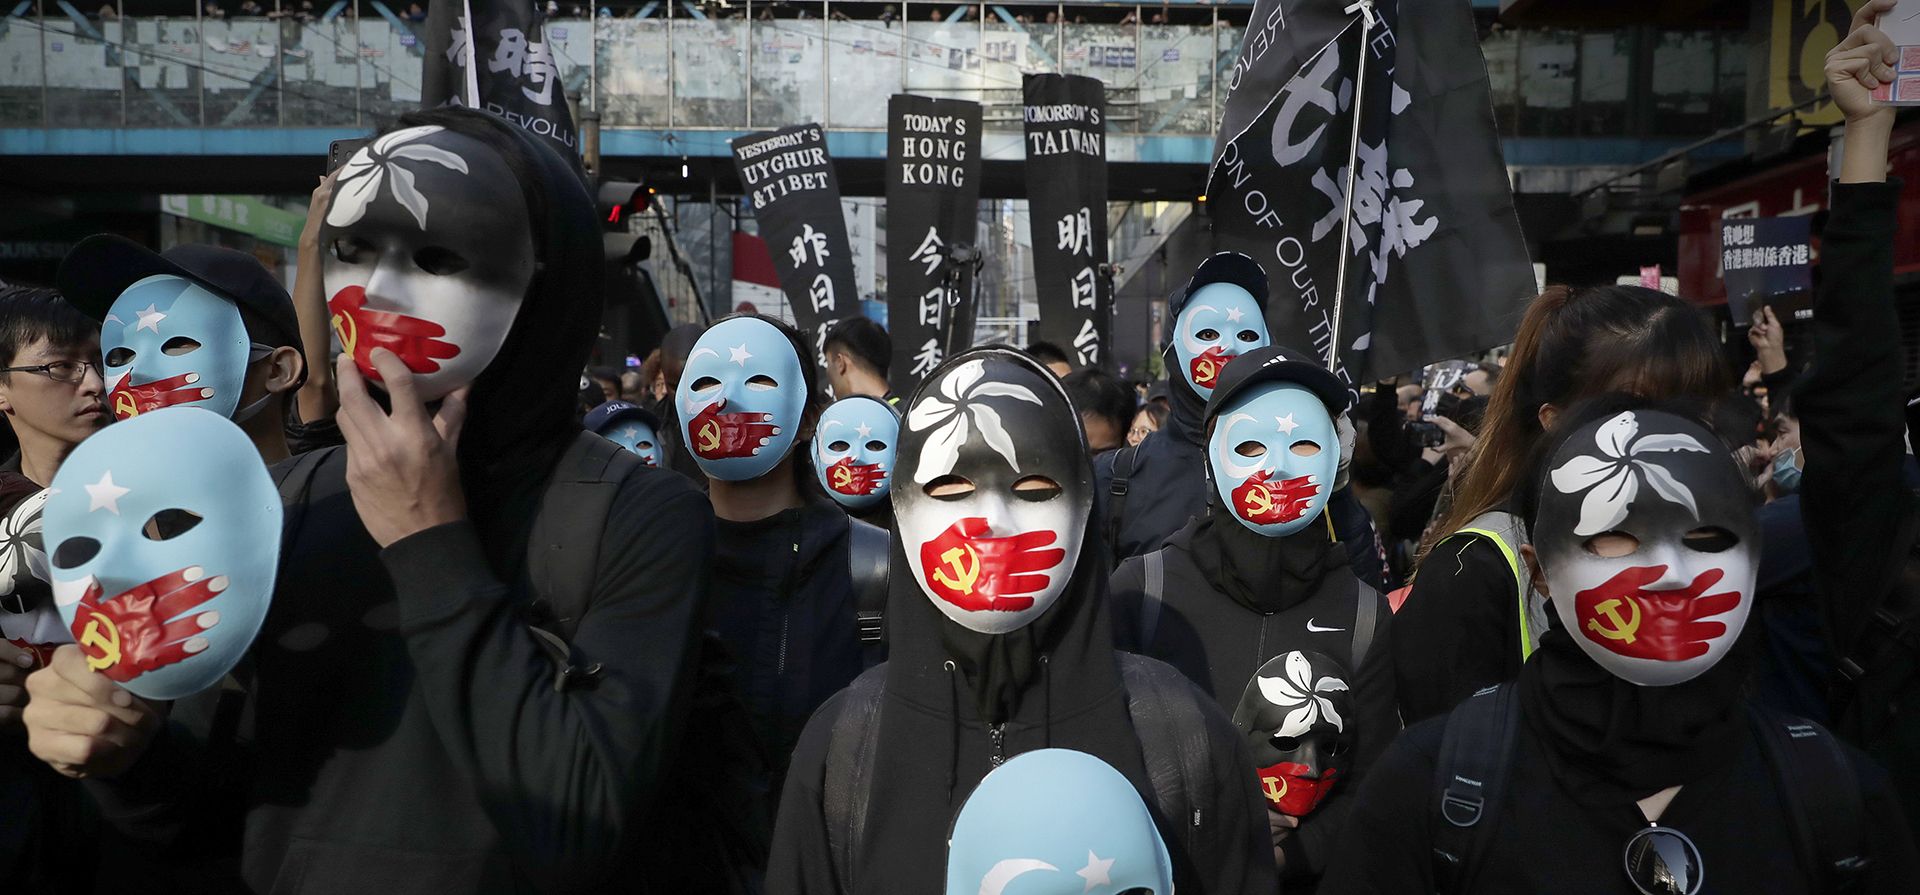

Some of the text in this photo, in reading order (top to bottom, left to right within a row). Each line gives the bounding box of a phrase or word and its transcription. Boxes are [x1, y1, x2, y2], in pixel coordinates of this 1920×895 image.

[903, 114, 967, 136] TODAY'S
[736, 128, 821, 160] YESTERDAY'S
[902, 137, 966, 162] HONG
[1029, 128, 1100, 156] TAIWAN
[742, 147, 827, 185] UYGHUR
[902, 163, 964, 188] KONG
[1244, 190, 1284, 229] OF
[1276, 236, 1319, 312] OUR
